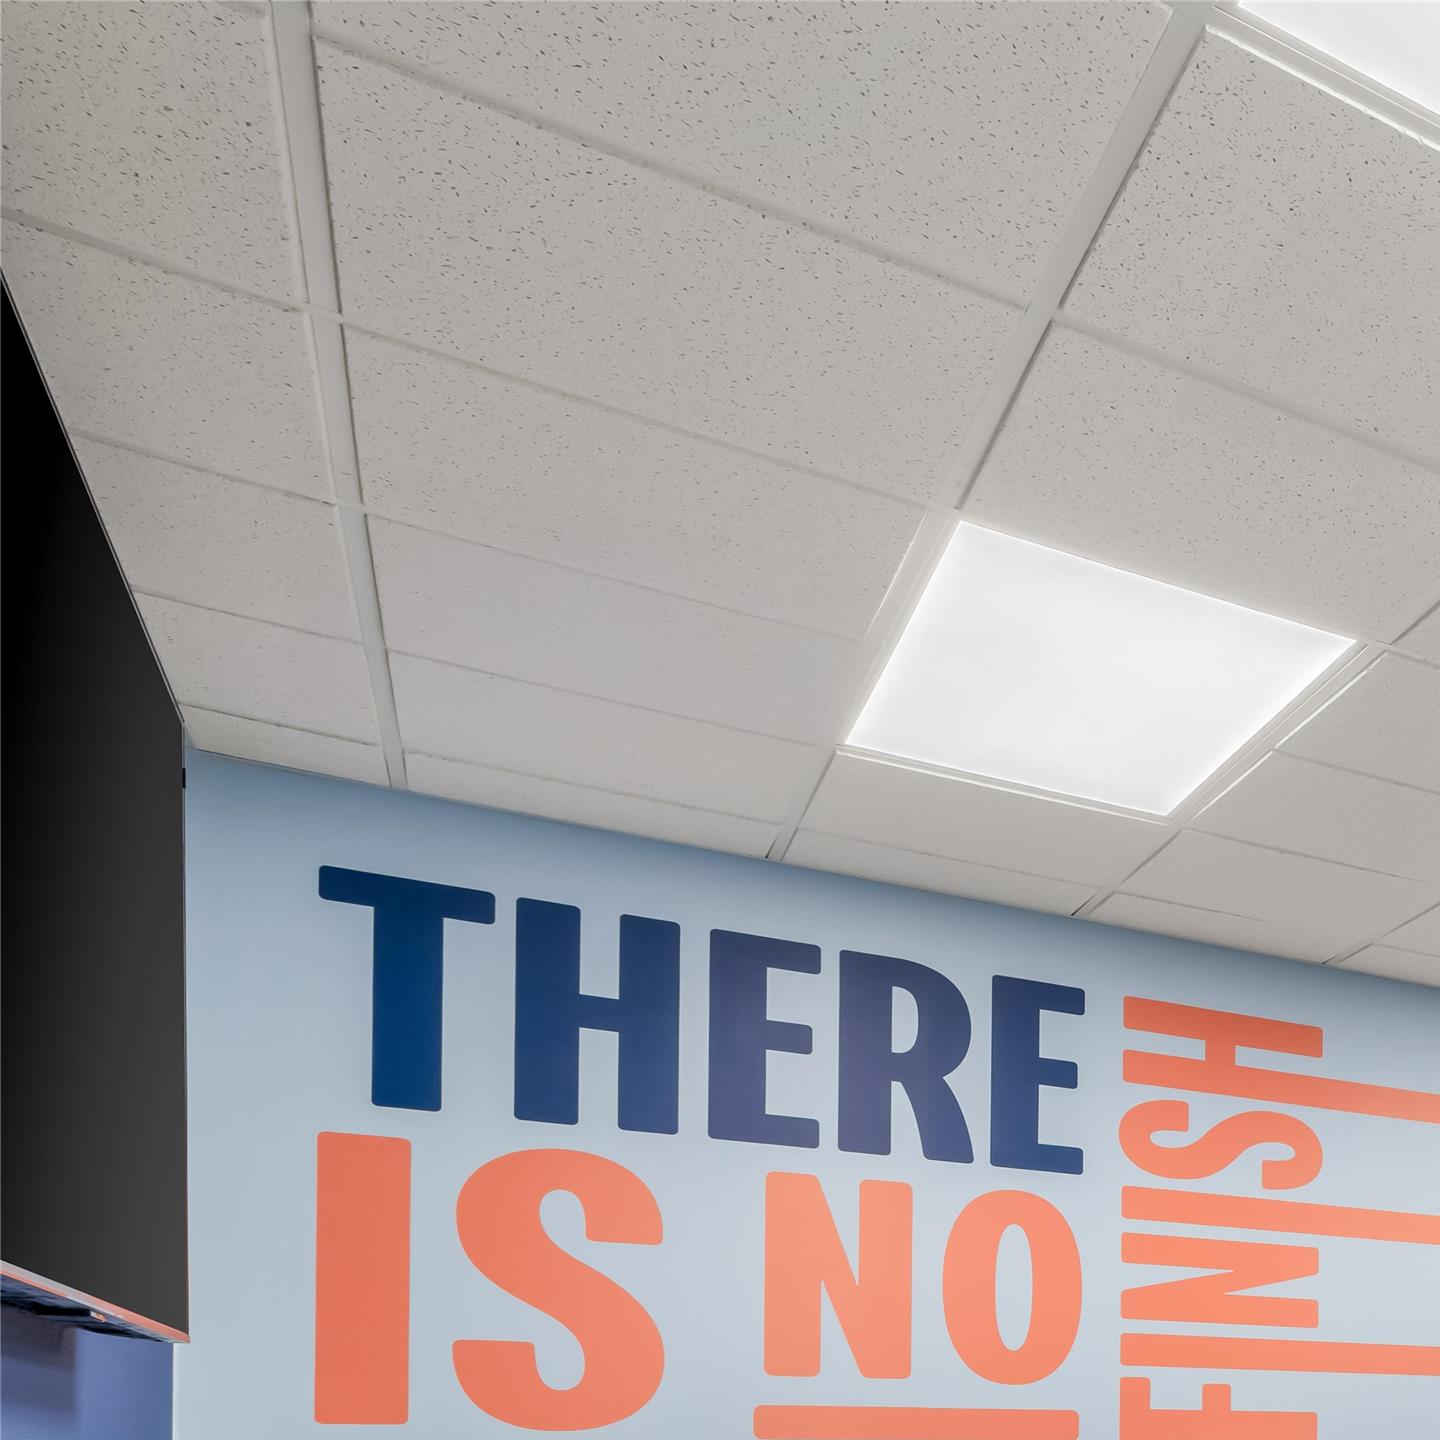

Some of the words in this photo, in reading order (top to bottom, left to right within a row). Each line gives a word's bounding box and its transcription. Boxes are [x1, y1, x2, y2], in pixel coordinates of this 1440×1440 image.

[318, 865, 1086, 1176] THERE
[314, 1131, 665, 1431] IS
[764, 1171, 1083, 1386] NO
